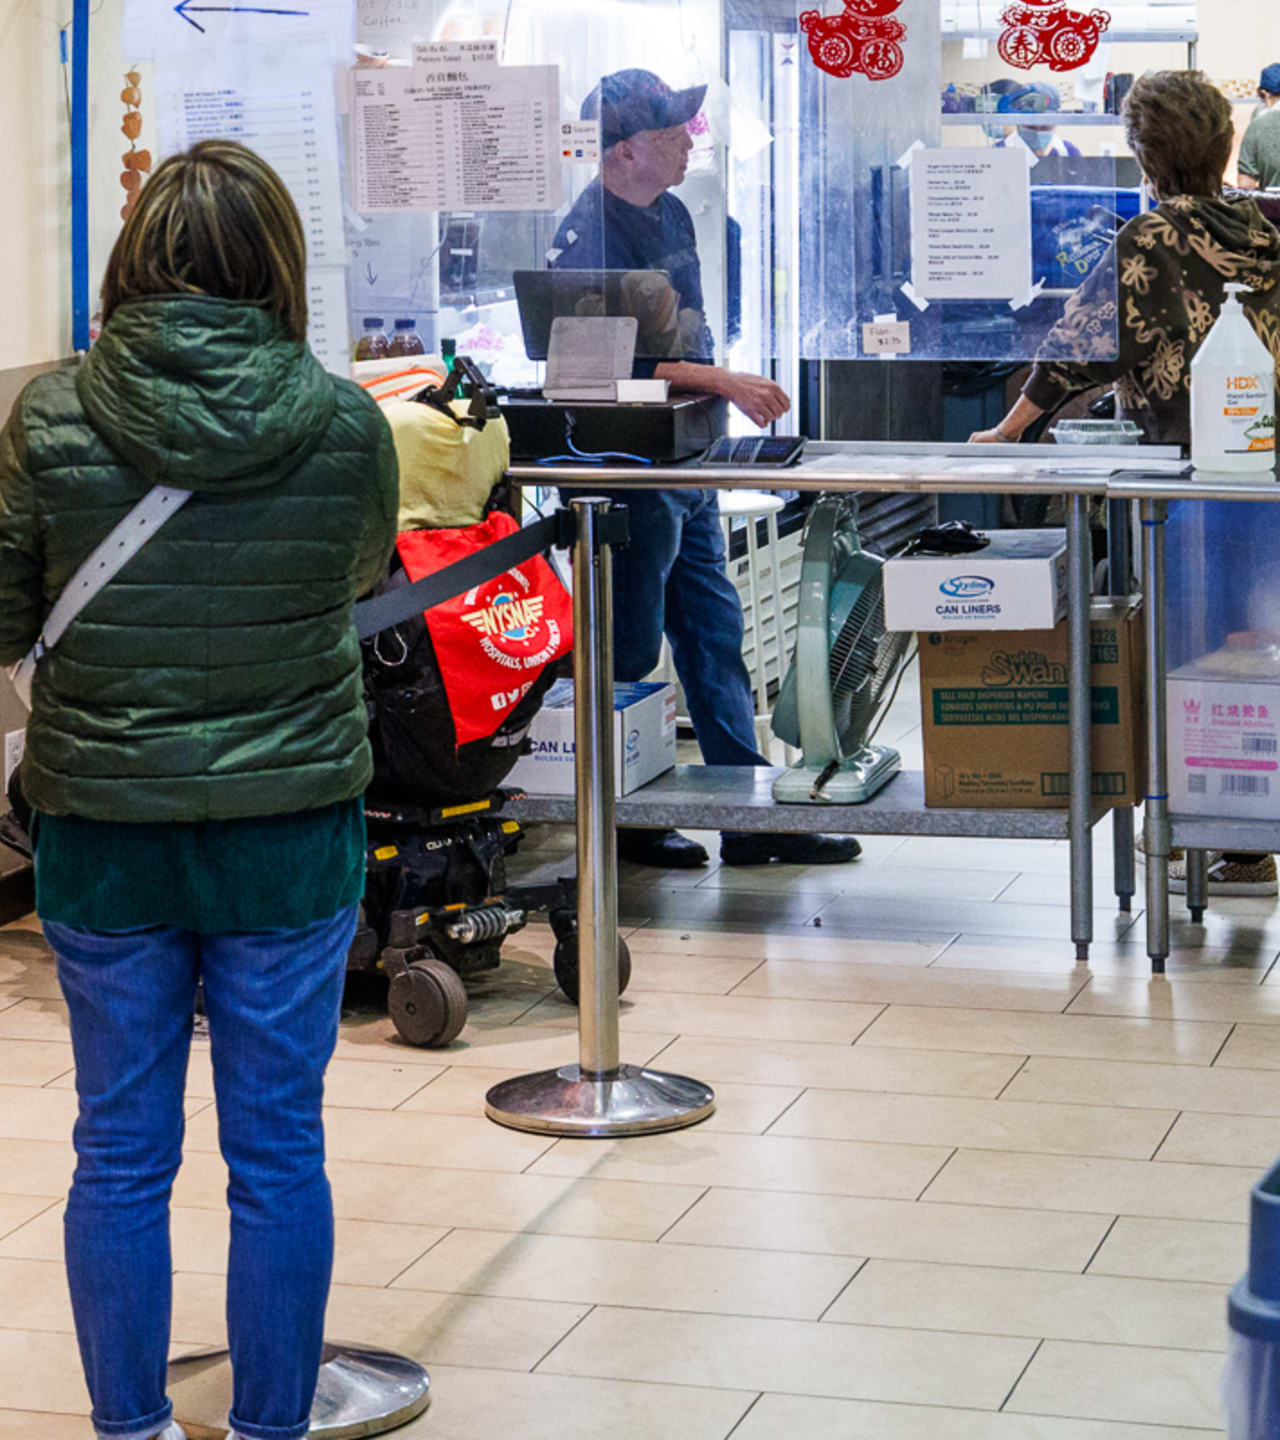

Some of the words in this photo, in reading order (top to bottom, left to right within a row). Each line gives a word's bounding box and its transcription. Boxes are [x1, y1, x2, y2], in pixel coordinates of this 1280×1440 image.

[1225, 376, 1259, 390] HDX
[936, 605, 959, 615] CAN
[961, 604, 1002, 615] LINERS
[480, 600, 540, 637] NYSNA
[981, 650, 1070, 686] Swan
[530, 740, 559, 753] CAN
